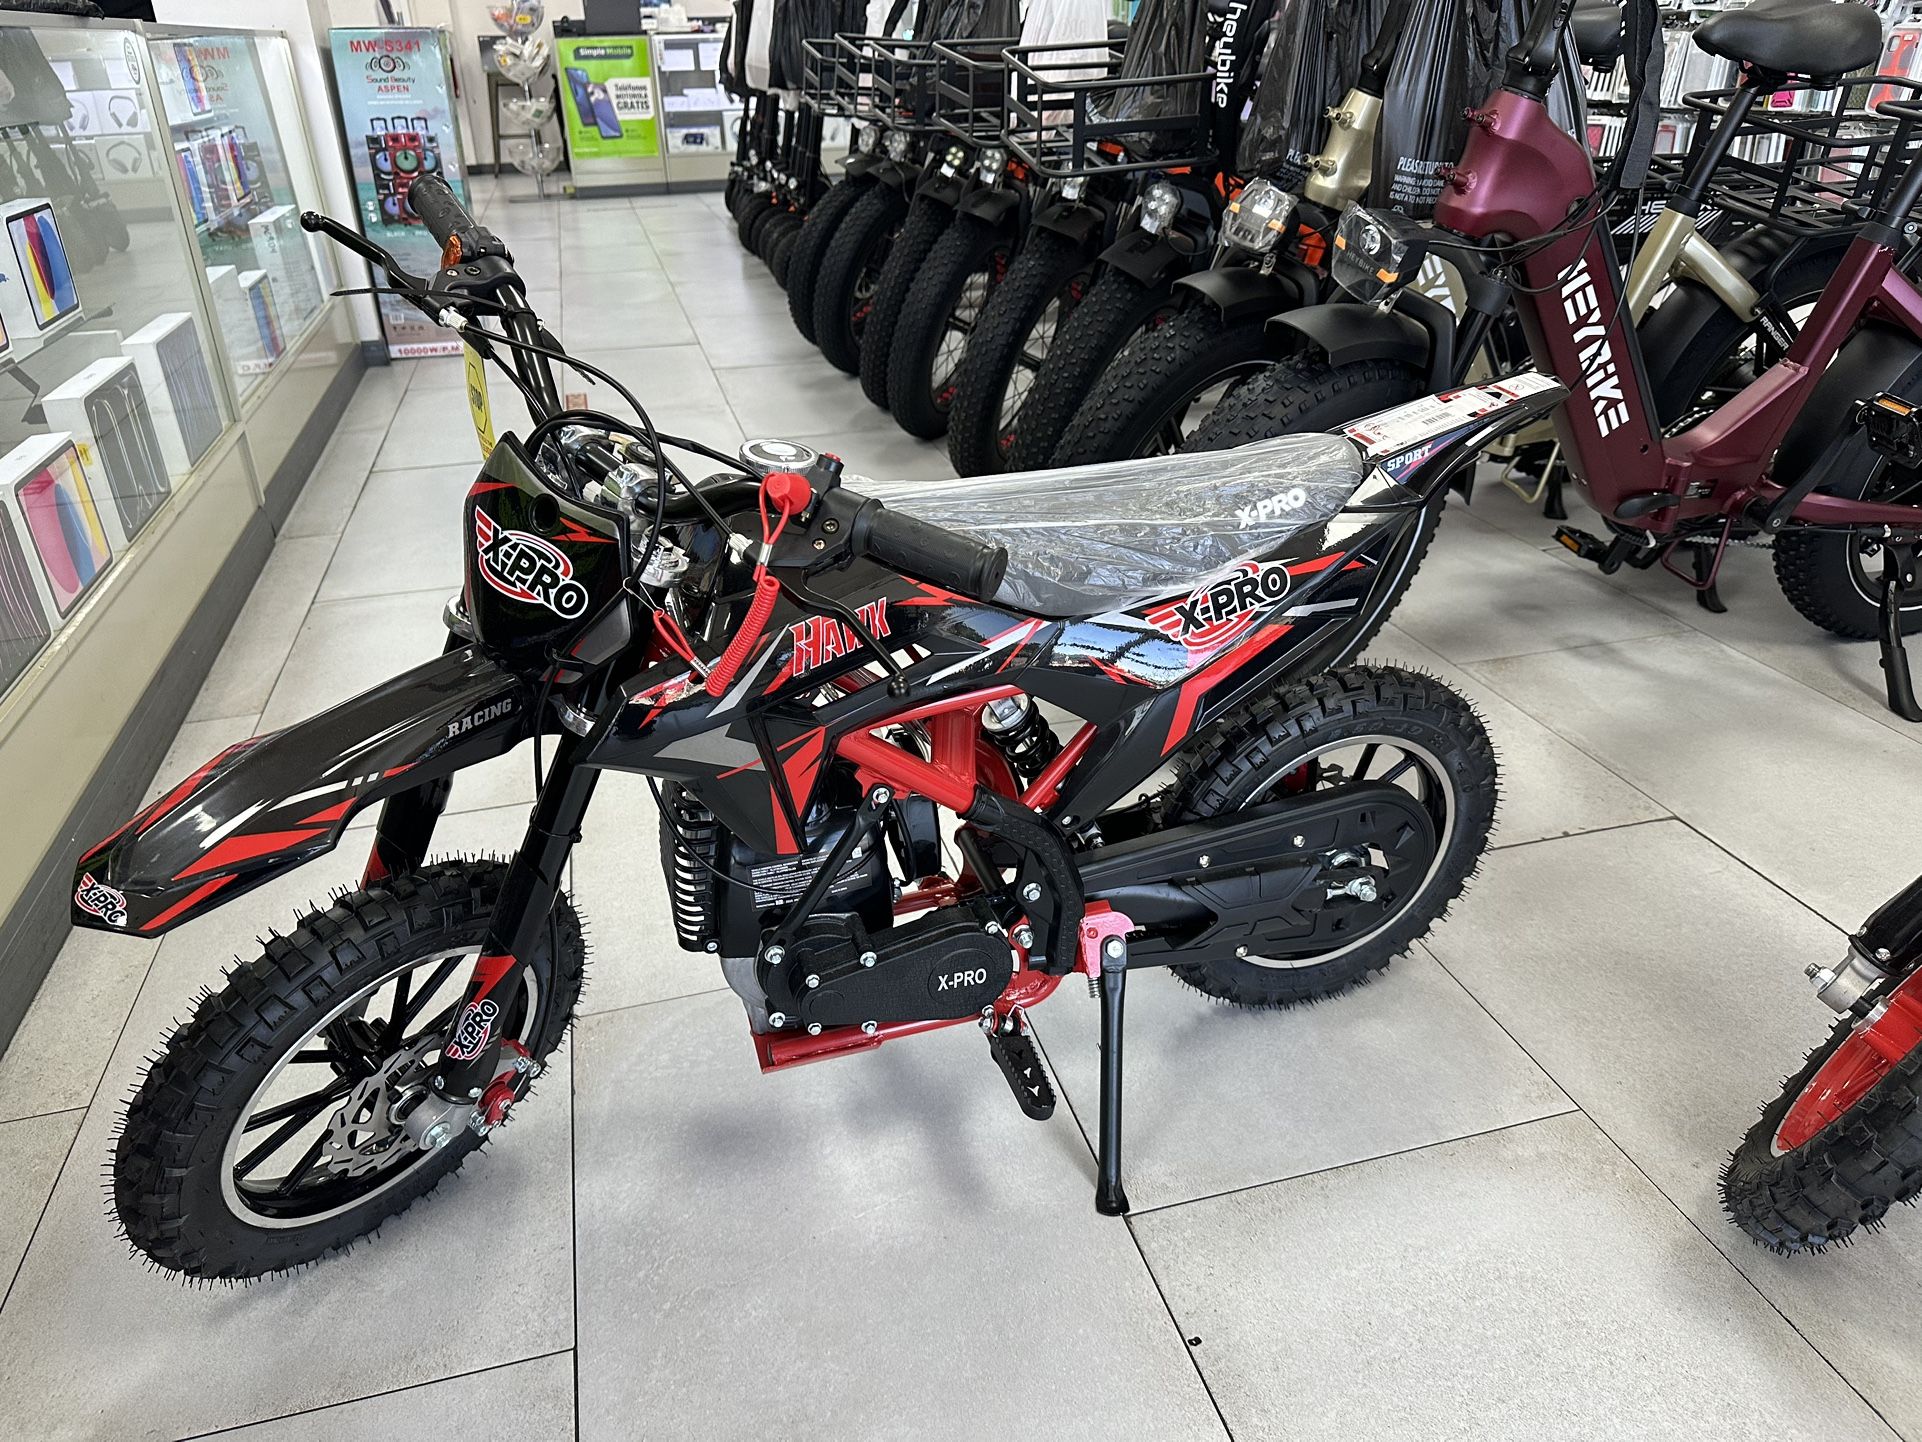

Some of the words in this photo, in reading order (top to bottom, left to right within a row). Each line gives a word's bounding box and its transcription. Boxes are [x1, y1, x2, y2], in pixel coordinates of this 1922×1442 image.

[349, 40, 421, 53] MW-S341
[579, 47, 605, 57] Simple
[1216, 1, 1248, 108] heybike
[366, 75, 390, 84] Sound
[377, 85, 410, 93] ASPEN
[616, 100, 650, 110] GRATIS
[1759, 315, 1790, 351] RANGER
[1386, 443, 1433, 473] SPORT
[1234, 487, 1307, 530] X-PRO
[480, 527, 588, 619] X-PRO
[1173, 565, 1291, 638] X-PRO
[788, 596, 892, 678] HAWK
[446, 698, 512, 739] RACING
[79, 882, 129, 927] X-PRO
[937, 968, 987, 992] X-PRO
[453, 999, 500, 1056] X-PRO
